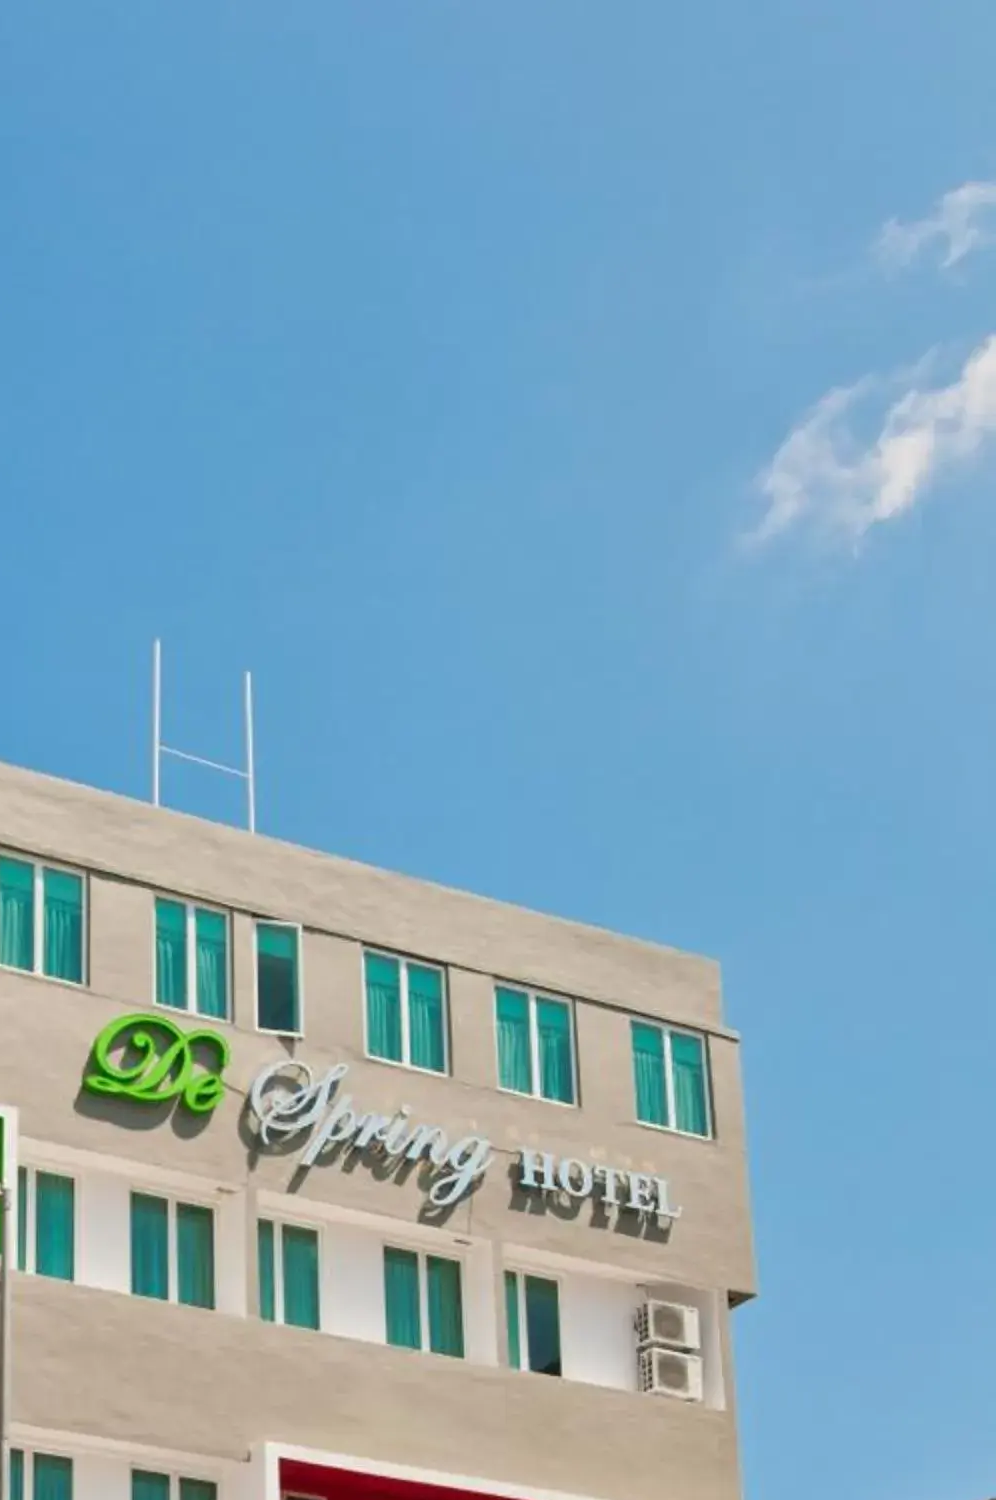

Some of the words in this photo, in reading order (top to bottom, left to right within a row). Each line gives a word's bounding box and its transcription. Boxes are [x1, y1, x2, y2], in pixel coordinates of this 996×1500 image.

[85, 1012, 229, 1114] De
[251, 1061, 495, 1206] Spring
[518, 1147, 683, 1219] HOTEL
